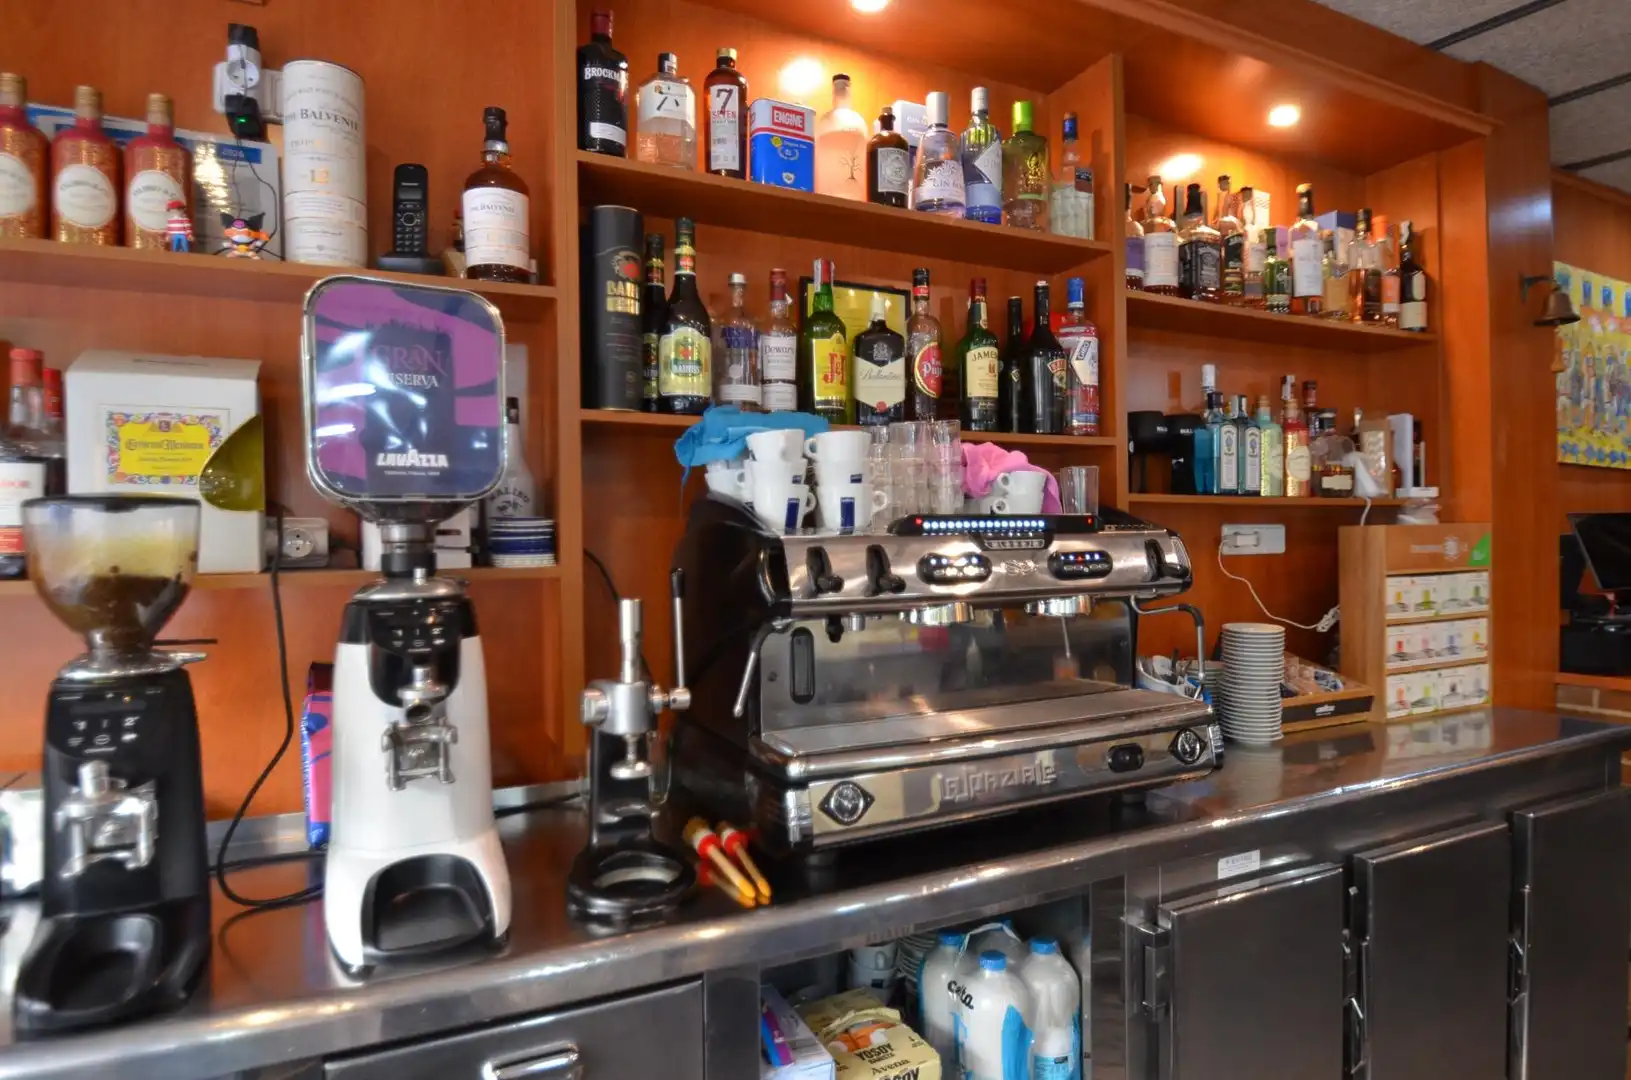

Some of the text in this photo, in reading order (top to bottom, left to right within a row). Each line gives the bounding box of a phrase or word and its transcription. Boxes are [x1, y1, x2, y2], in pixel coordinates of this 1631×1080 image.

[775, 111, 804, 128] ENGINE
[376, 449, 449, 468] LAVAZZA
[856, 1043, 894, 1061] YOSOY
[871, 1059, 912, 1076] Avena
